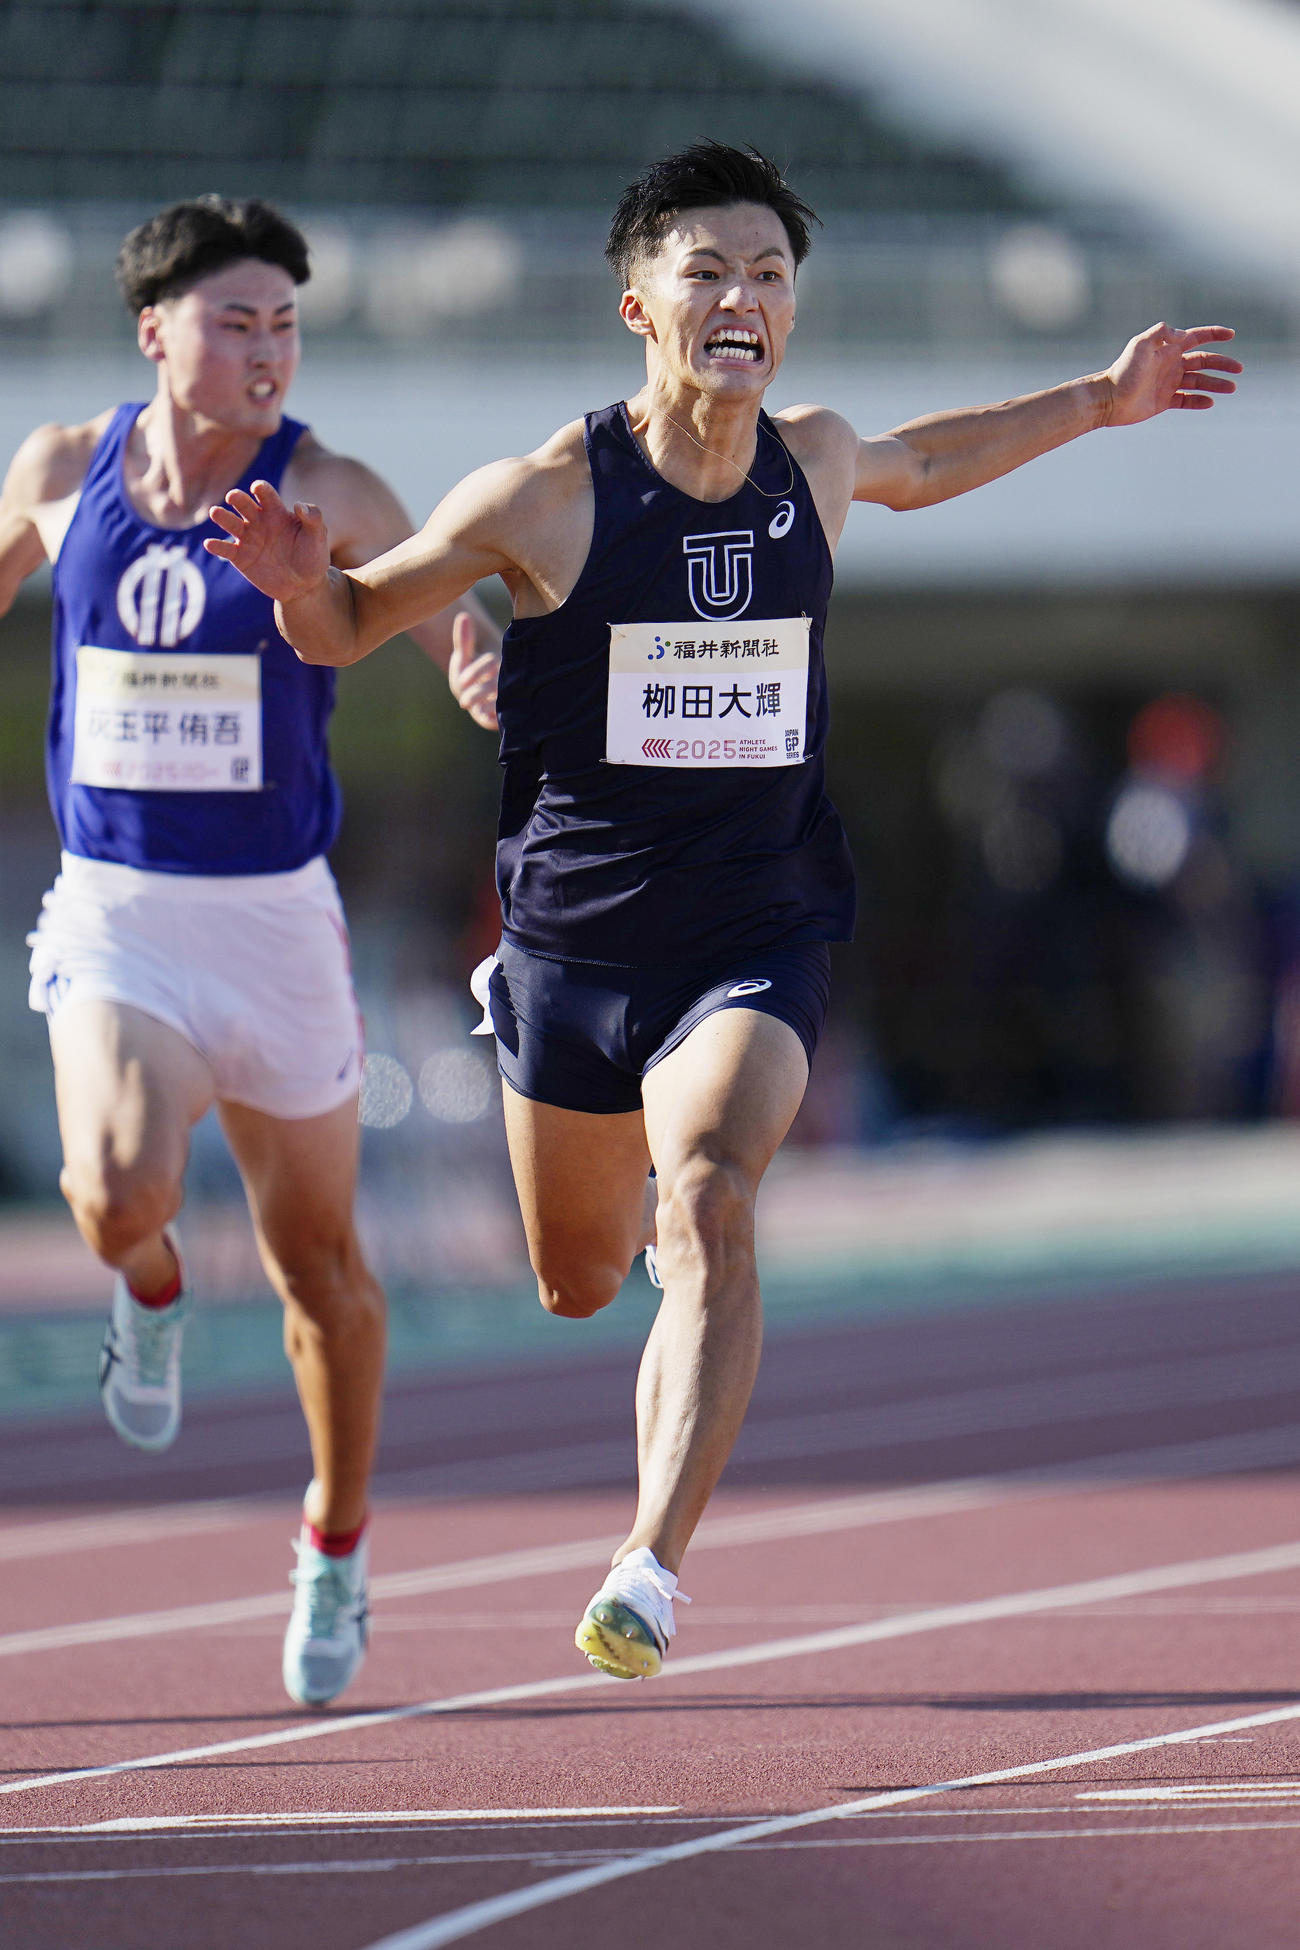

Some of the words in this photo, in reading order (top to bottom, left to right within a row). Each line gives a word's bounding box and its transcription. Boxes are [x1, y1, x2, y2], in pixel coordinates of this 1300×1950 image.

[673, 638, 780, 659] 福井新聞社
[785, 729, 799, 737] JAPAN
[675, 739, 737, 760] 2025
[785, 736, 799, 752] GP
[786, 751, 800, 759] SERIES
